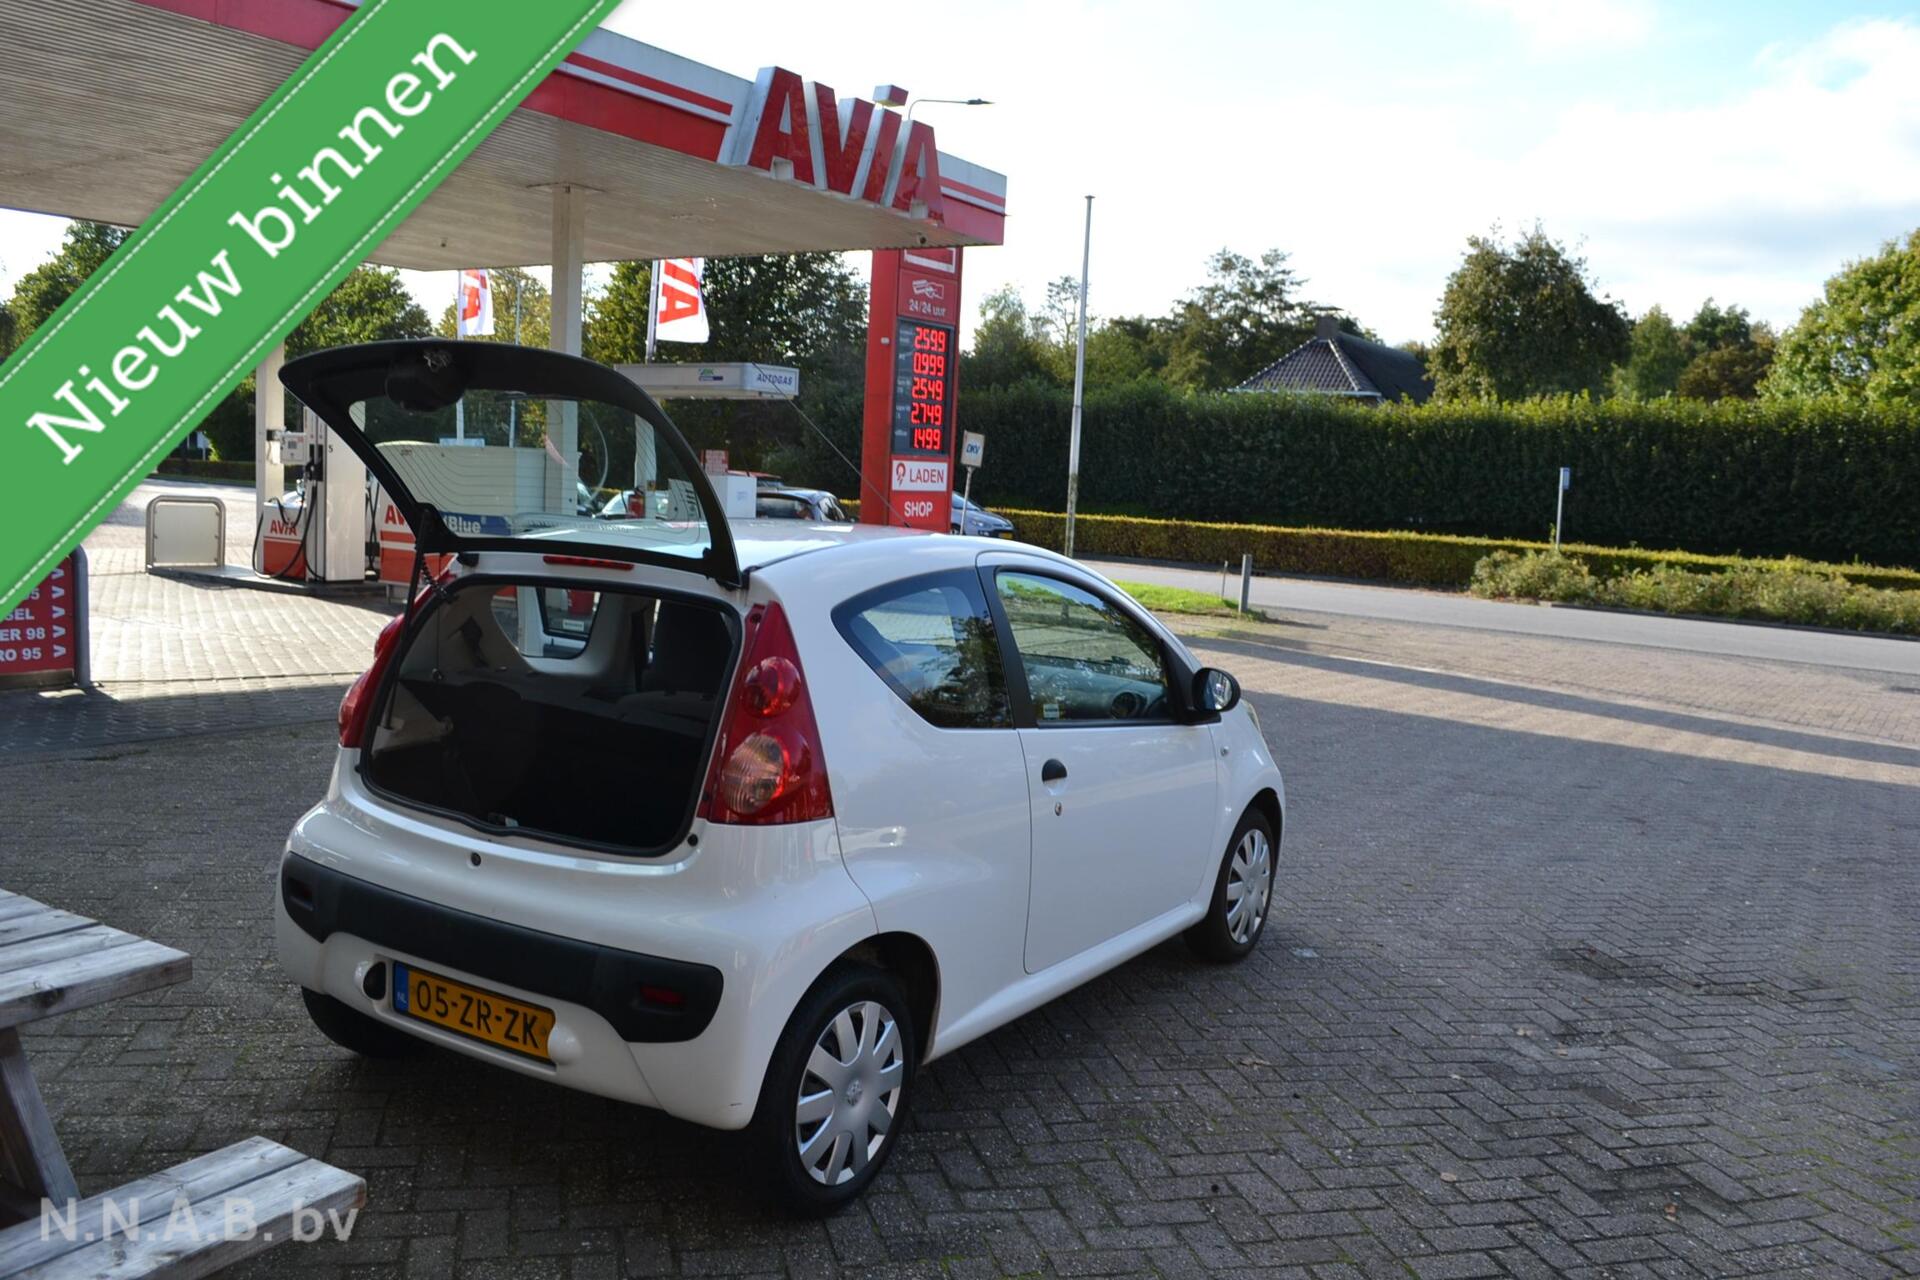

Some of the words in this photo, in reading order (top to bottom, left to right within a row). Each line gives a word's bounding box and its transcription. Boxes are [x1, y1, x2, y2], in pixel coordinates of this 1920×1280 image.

[746, 65, 945, 224] AVIA
[909, 468, 944, 484] LADEN
[904, 500, 933, 517] SHOP
[26, 627, 45, 640] 98
[22, 647, 42, 660] 95
[416, 980, 539, 1049] 05-ZR-ZK
